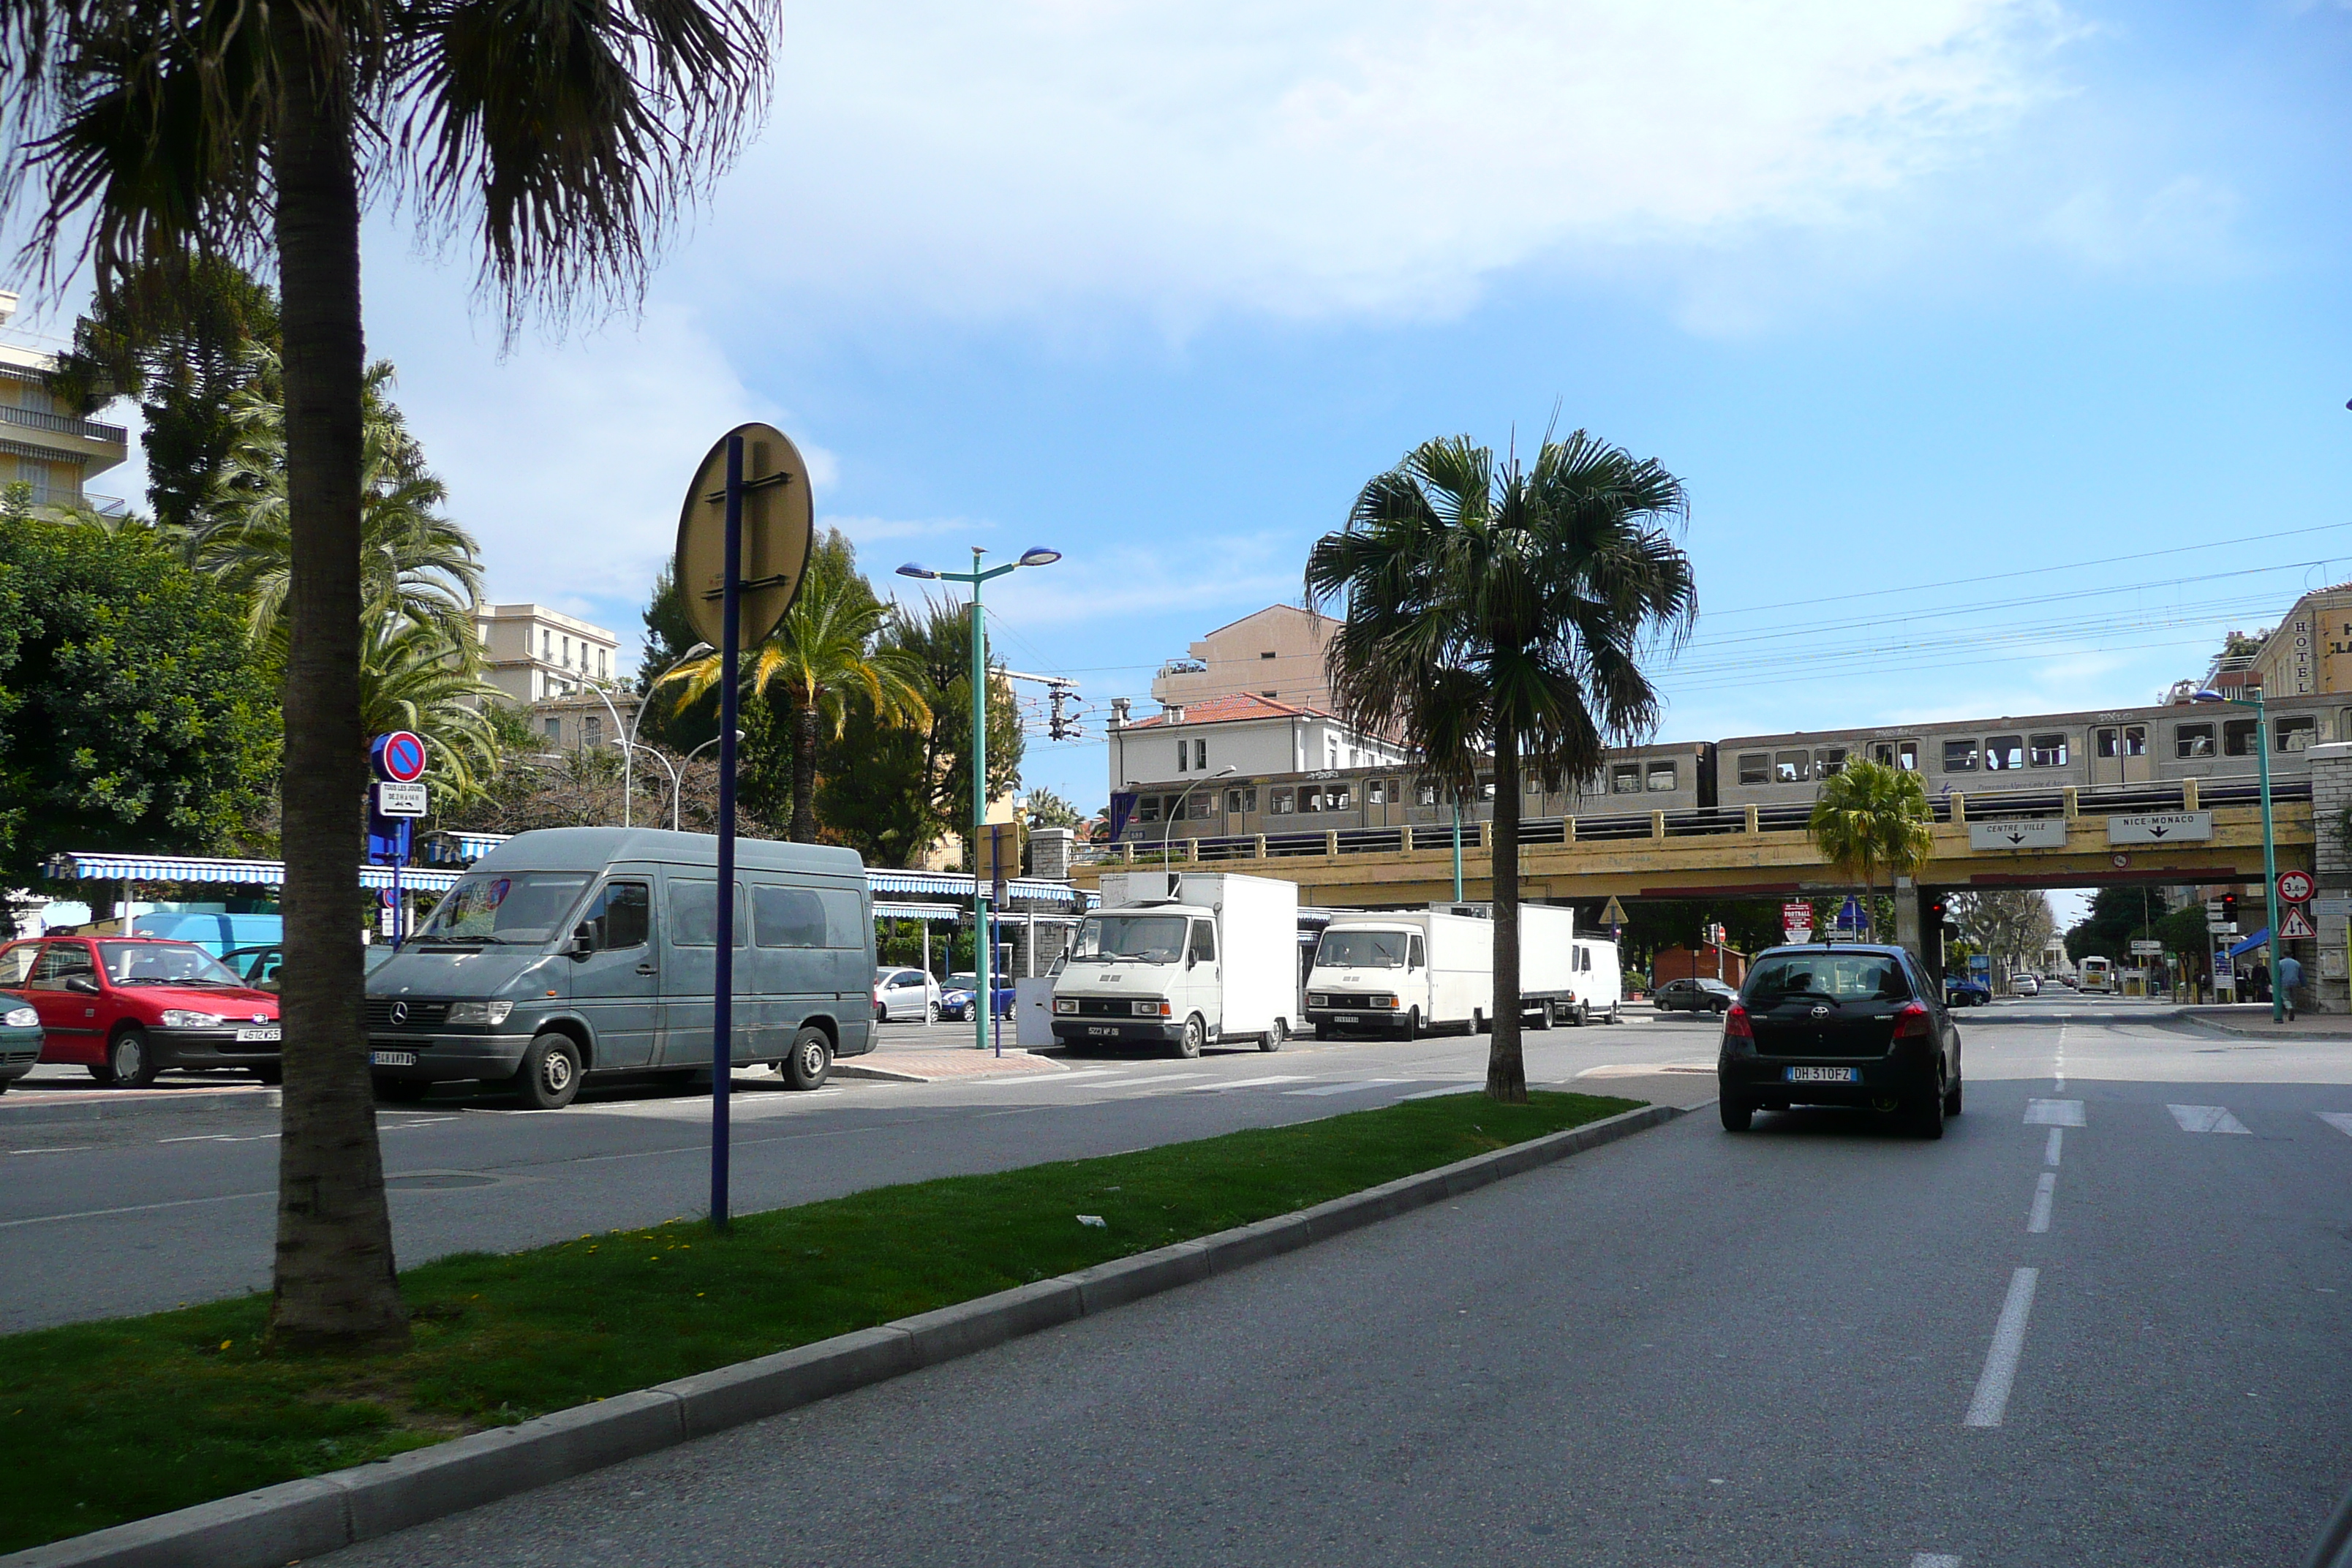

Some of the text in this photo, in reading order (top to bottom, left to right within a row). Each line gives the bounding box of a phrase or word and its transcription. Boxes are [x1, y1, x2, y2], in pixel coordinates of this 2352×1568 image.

[2295, 622, 2309, 693] HOTEL
[2123, 815, 2194, 826] NICE-MONACO
[1986, 823, 2046, 833] CENTRE VILLE
[1813, 1068, 1850, 1080] 310FZ
